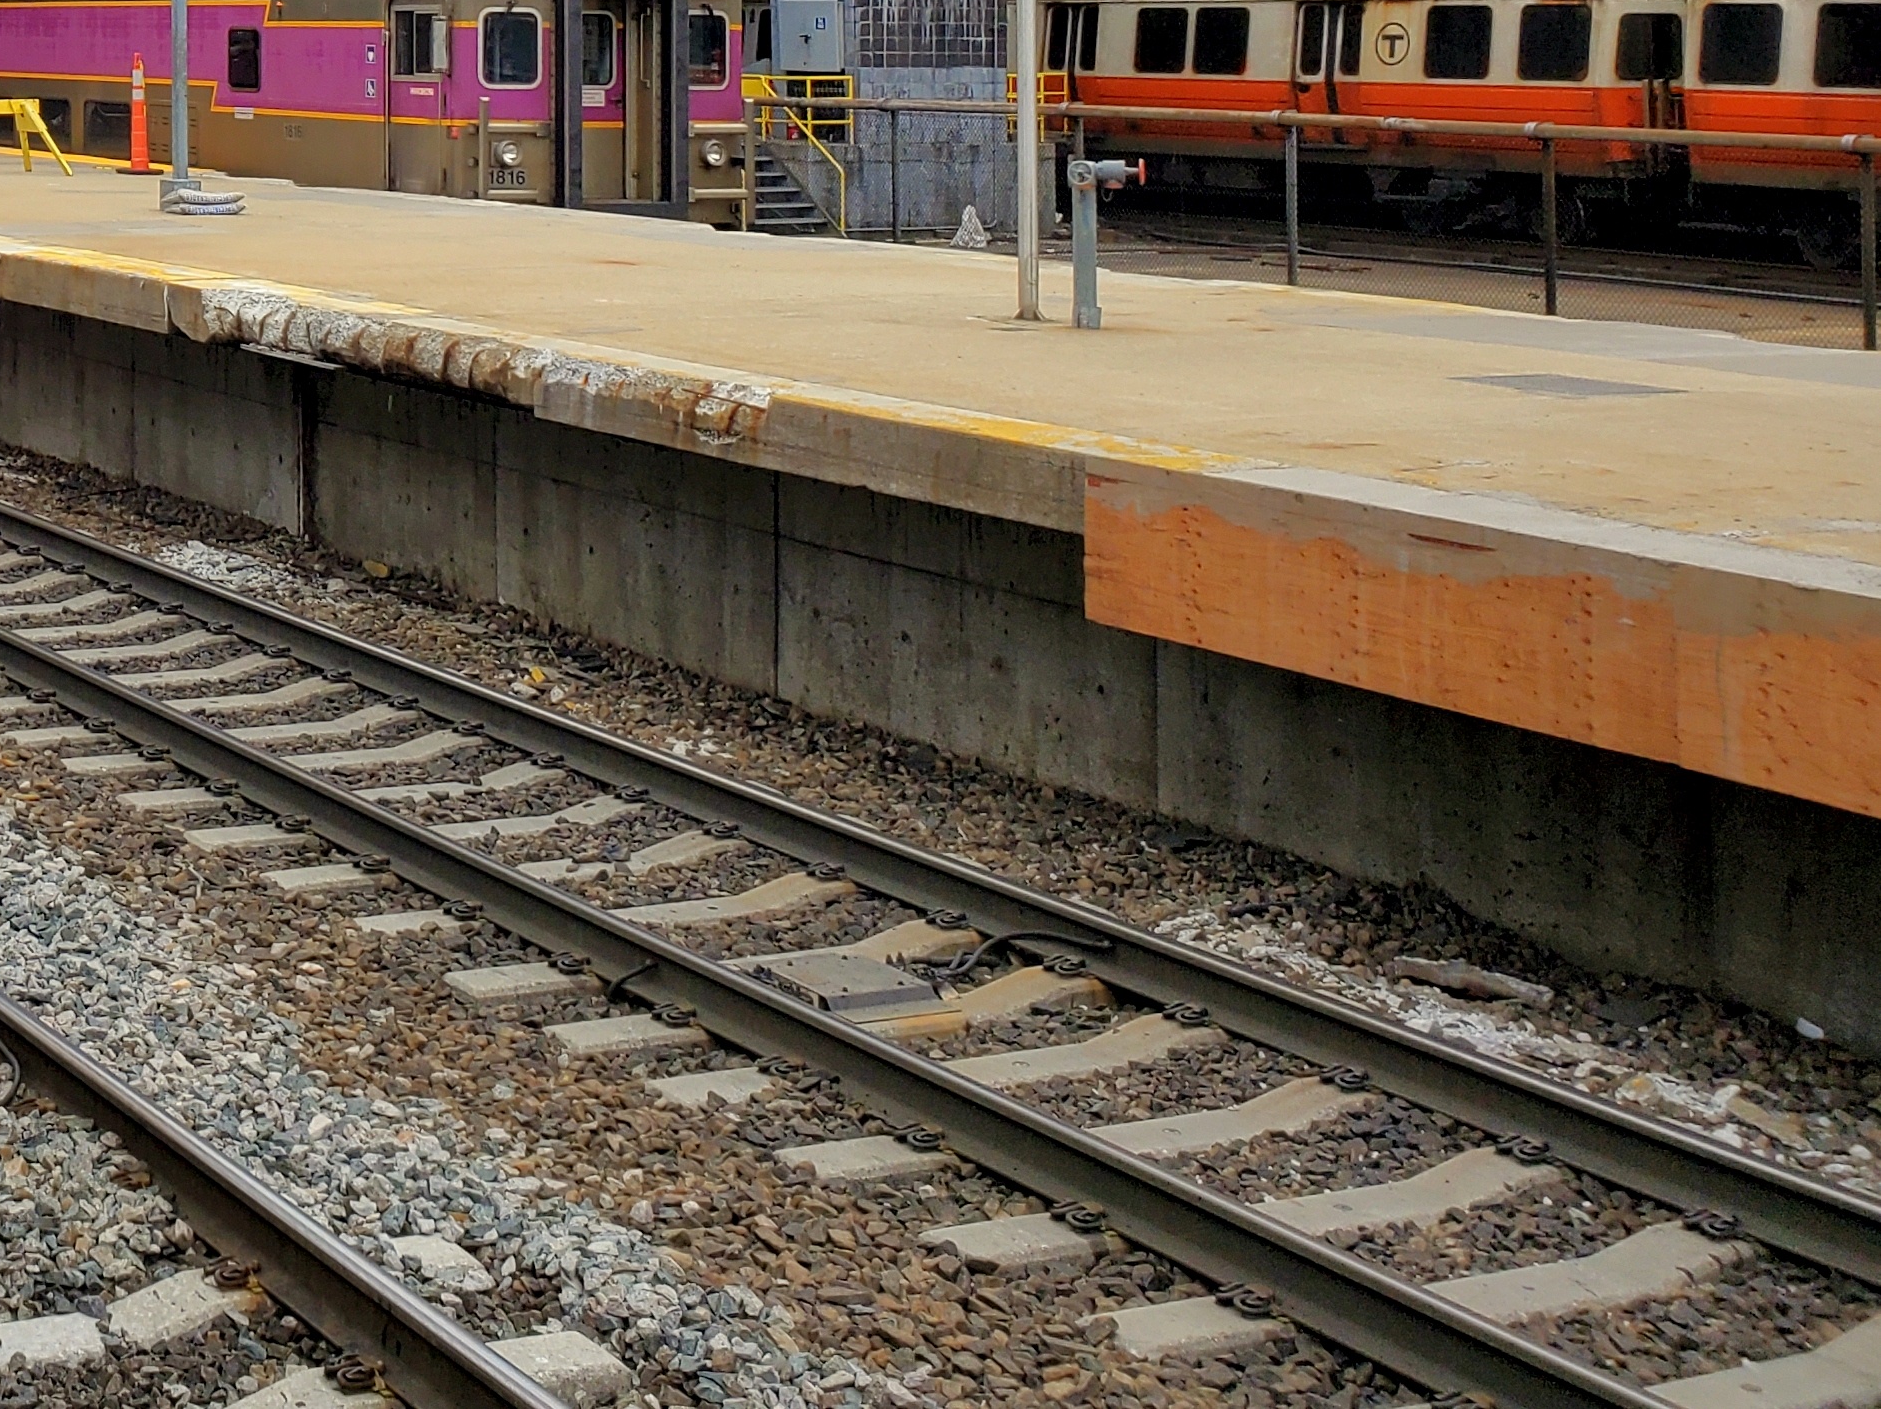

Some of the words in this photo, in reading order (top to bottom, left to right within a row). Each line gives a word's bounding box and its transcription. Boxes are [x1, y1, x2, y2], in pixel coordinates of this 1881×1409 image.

[1381, 34, 1404, 58] T
[284, 125, 302, 138] 1816
[488, 170, 526, 186] 1816
